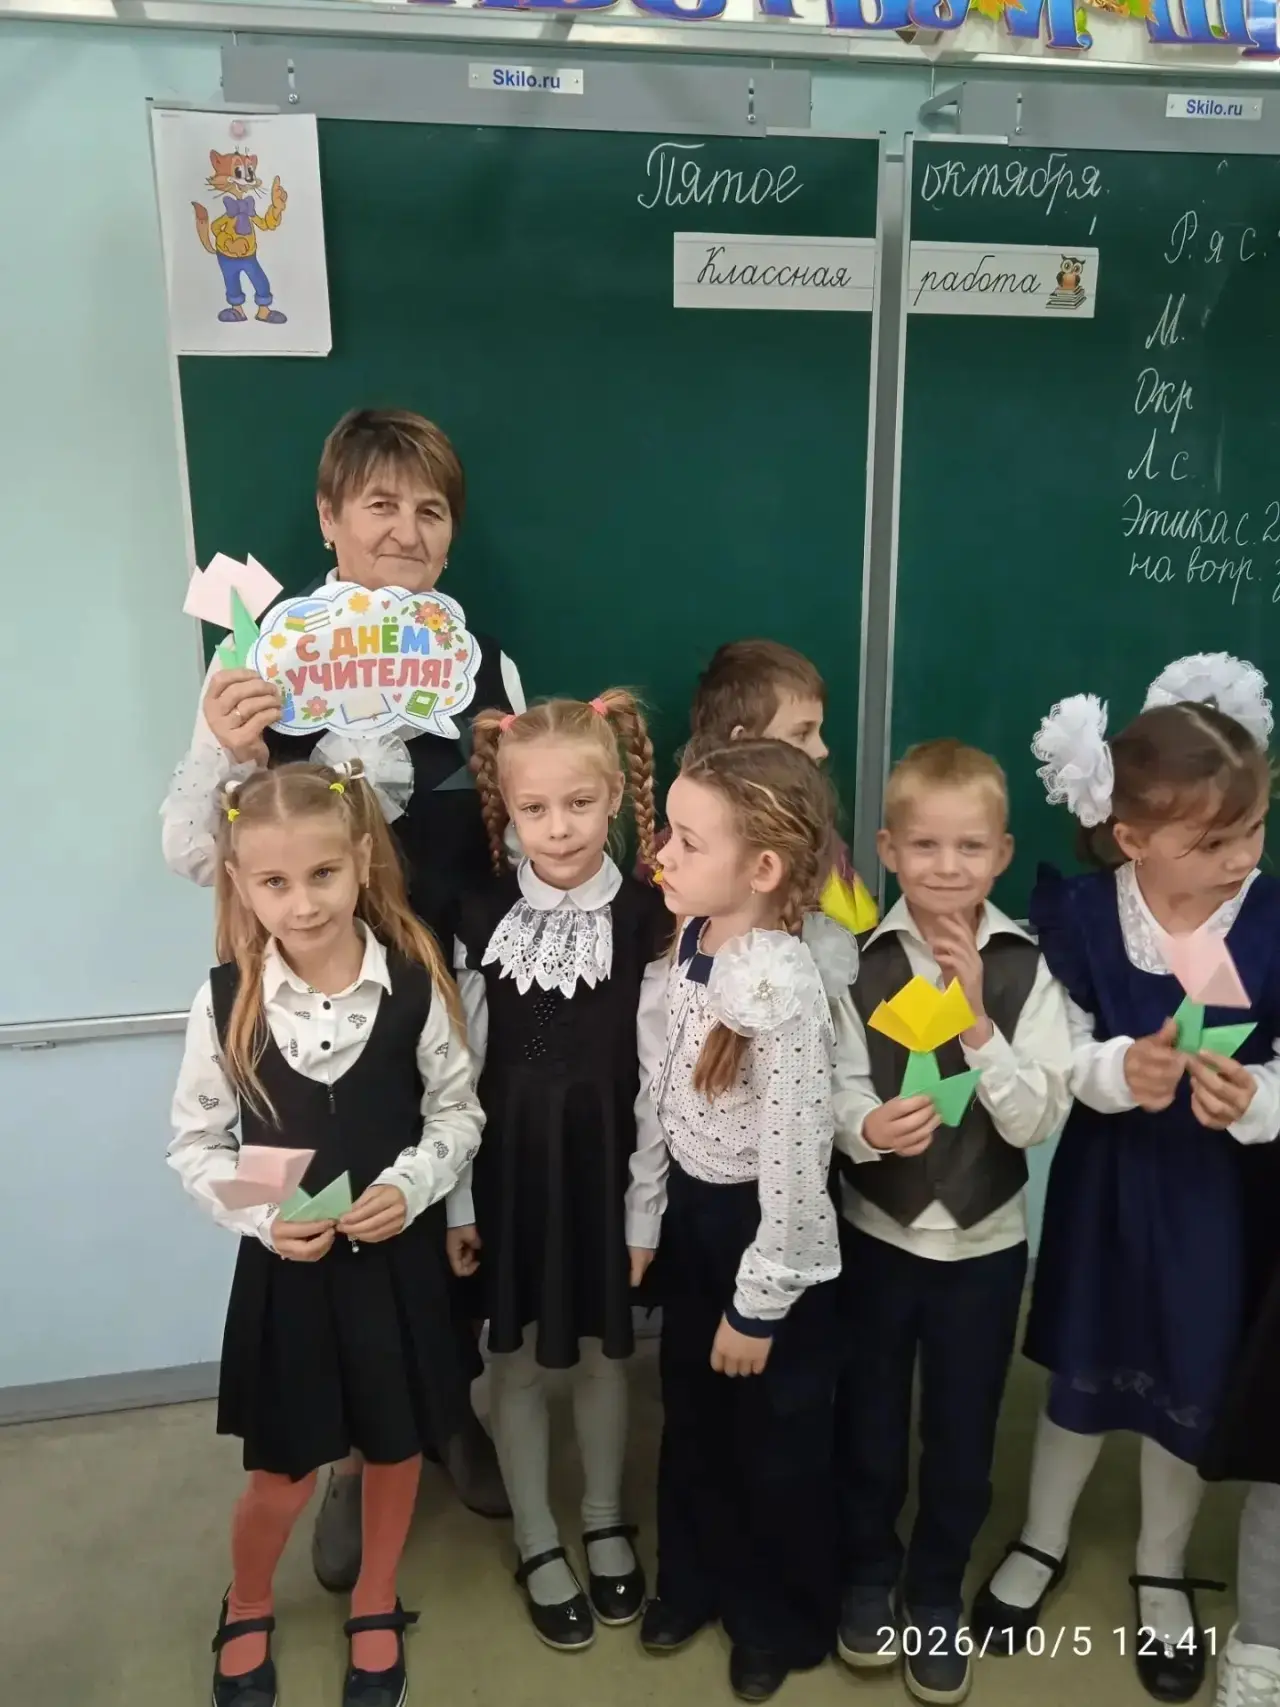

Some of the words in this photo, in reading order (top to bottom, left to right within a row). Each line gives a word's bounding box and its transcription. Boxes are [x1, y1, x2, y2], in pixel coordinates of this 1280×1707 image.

[493, 69, 560, 89] Skilo.ru
[1186, 99, 1243, 116] Skilo.ru
[637, 142, 804, 209] Пятое
[697, 246, 852, 287] Классная
[913, 255, 1042, 306] работа
[1129, 552, 1176, 583] на
[295, 633, 321, 662] С
[329, 616, 430, 662] ДНЁМ
[285, 657, 453, 697] УЧИТЕЛЯ!
